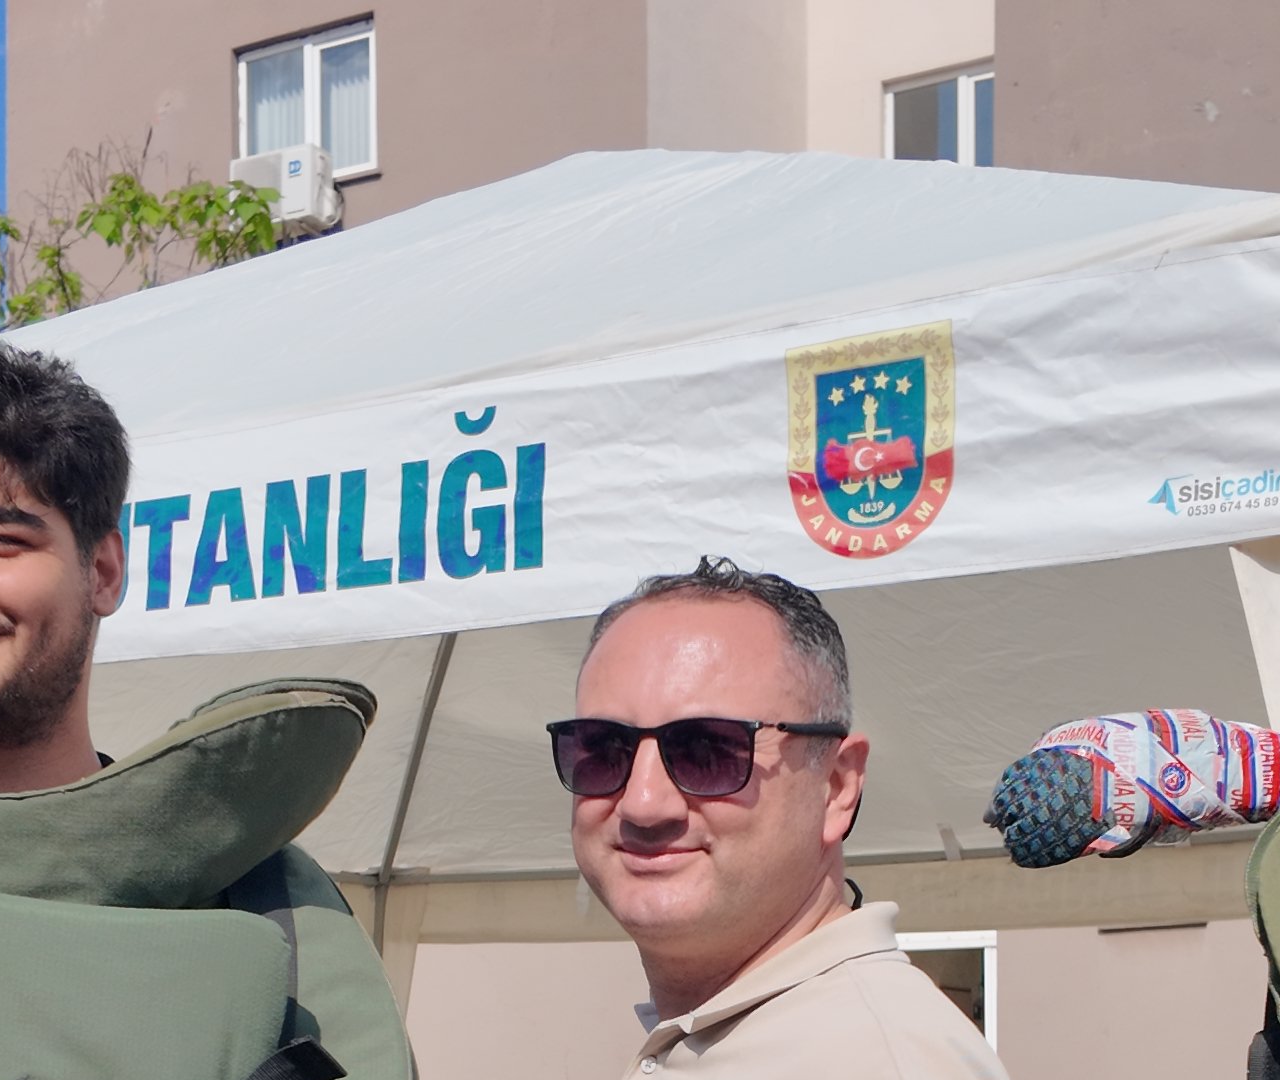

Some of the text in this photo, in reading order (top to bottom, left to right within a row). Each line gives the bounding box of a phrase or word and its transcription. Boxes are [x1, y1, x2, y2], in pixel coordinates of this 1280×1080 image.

[116, 405, 547, 612] TANLIĞI
[802, 476, 947, 552] JANDARMA
[859, 501, 884, 515] 1839
[1187, 496, 1279, 517] 0539 674 45 89
